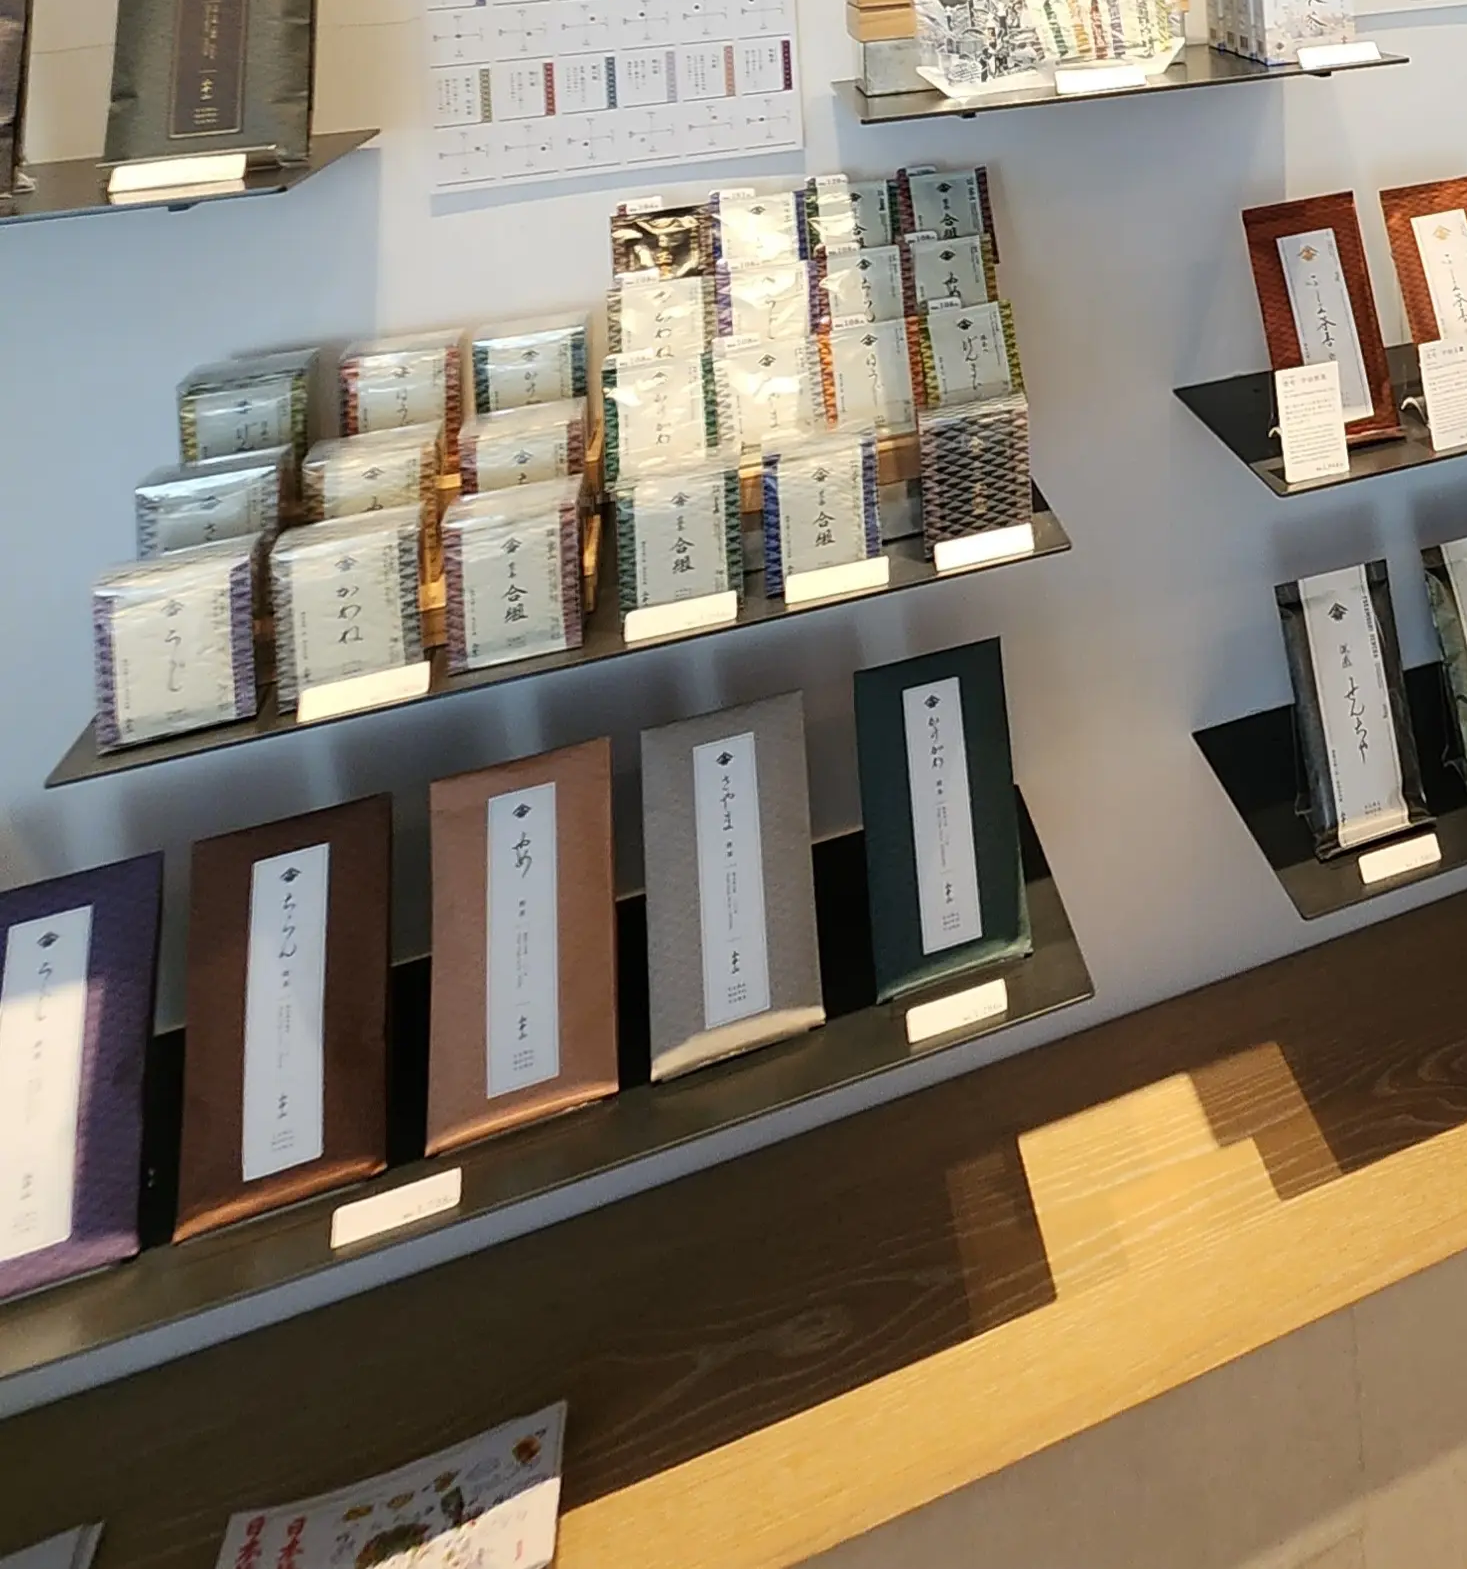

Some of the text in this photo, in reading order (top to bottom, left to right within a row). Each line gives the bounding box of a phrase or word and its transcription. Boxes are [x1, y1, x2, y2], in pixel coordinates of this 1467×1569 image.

[335, 584, 364, 646] かわね
[164, 628, 186, 693] うじ
[1343, 675, 1370, 764] せんちゃ
